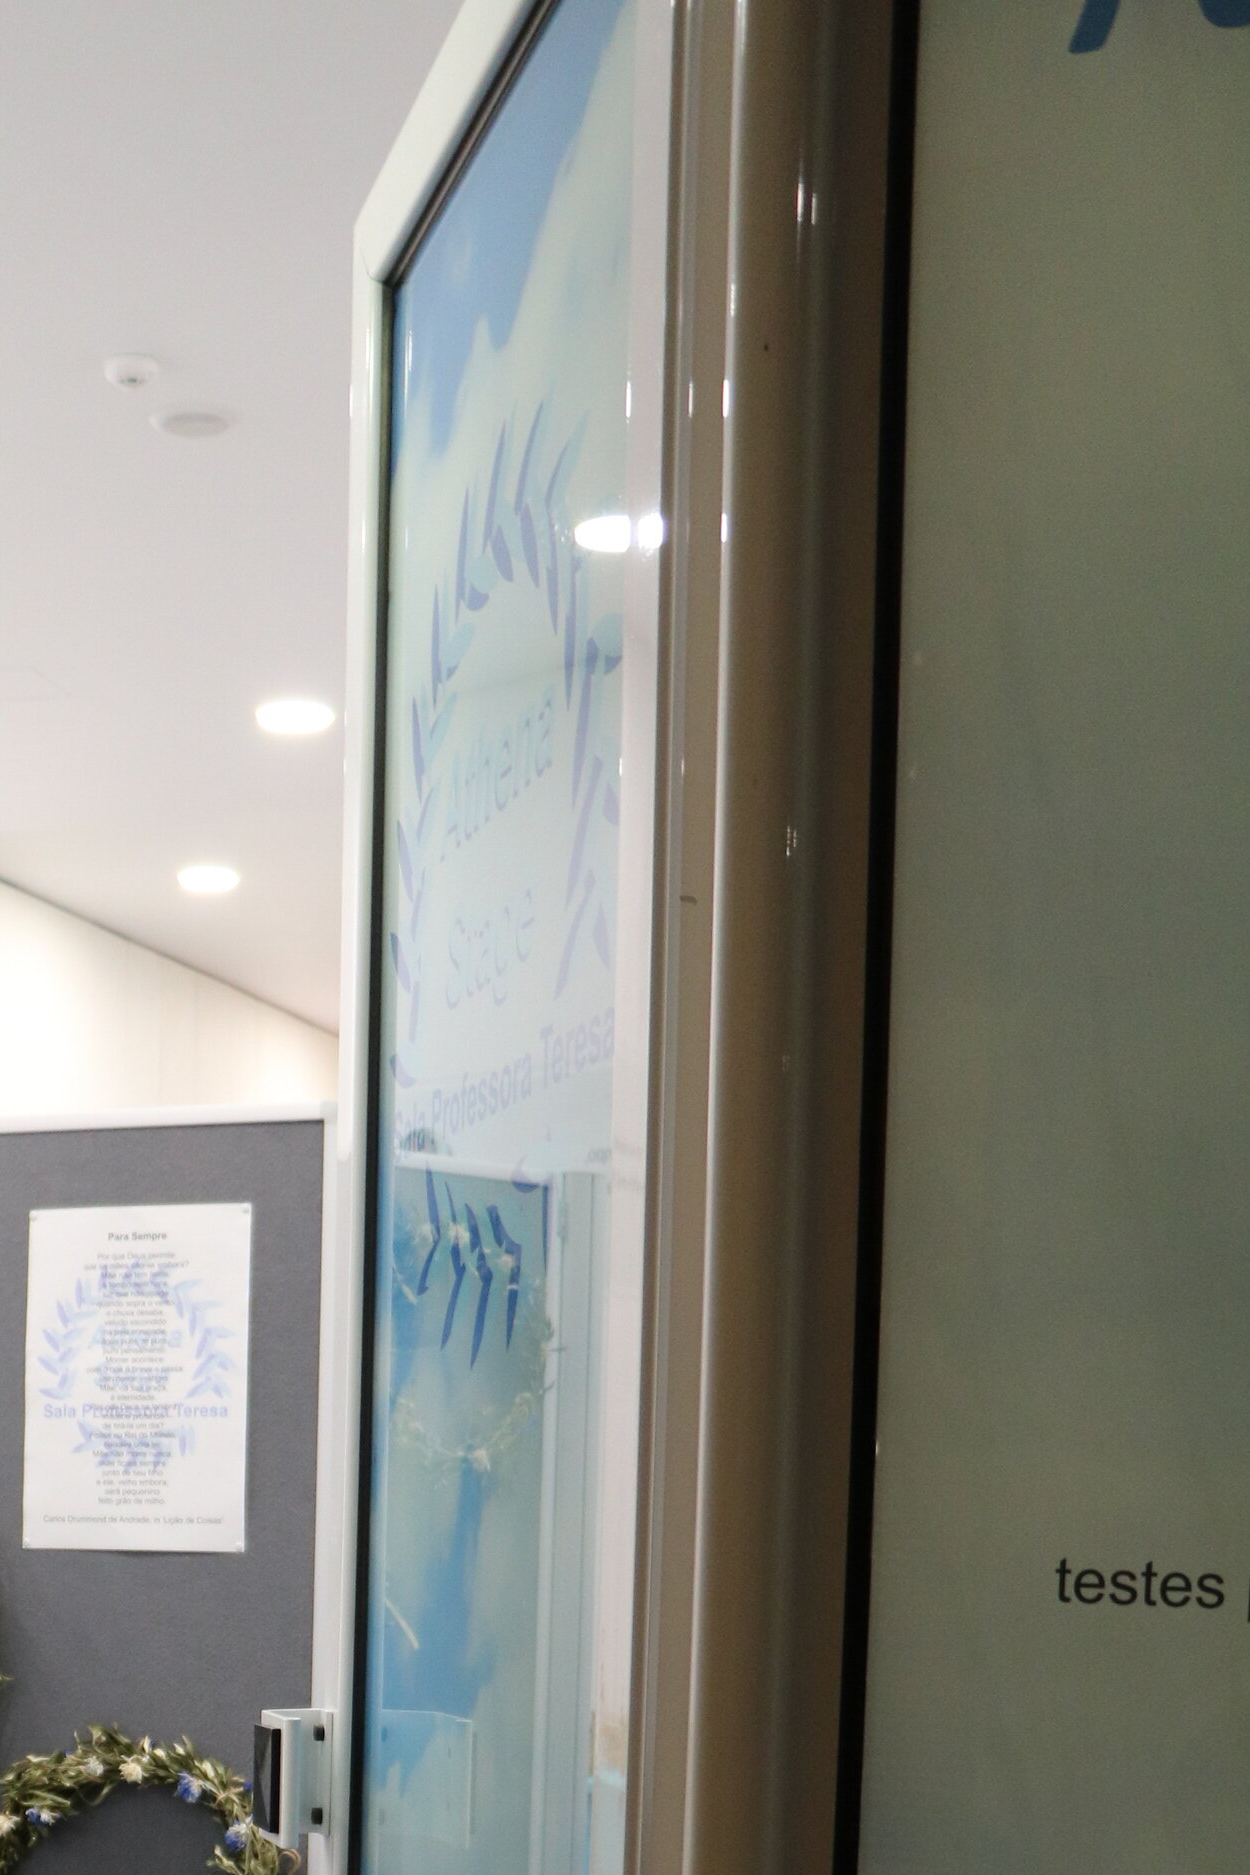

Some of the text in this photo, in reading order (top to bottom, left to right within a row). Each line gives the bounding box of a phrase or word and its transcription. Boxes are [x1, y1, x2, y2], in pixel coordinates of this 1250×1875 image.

[429, 1052, 533, 1140] Professora
[539, 1006, 616, 1090] Teresa
[108, 1232, 167, 1242] Para Sempre
[44, 1404, 76, 1418] Sala
[175, 1404, 228, 1418] Teresa
[43, 1514, 66, 1522] Carlos
[1056, 1558, 1225, 1608] testes
